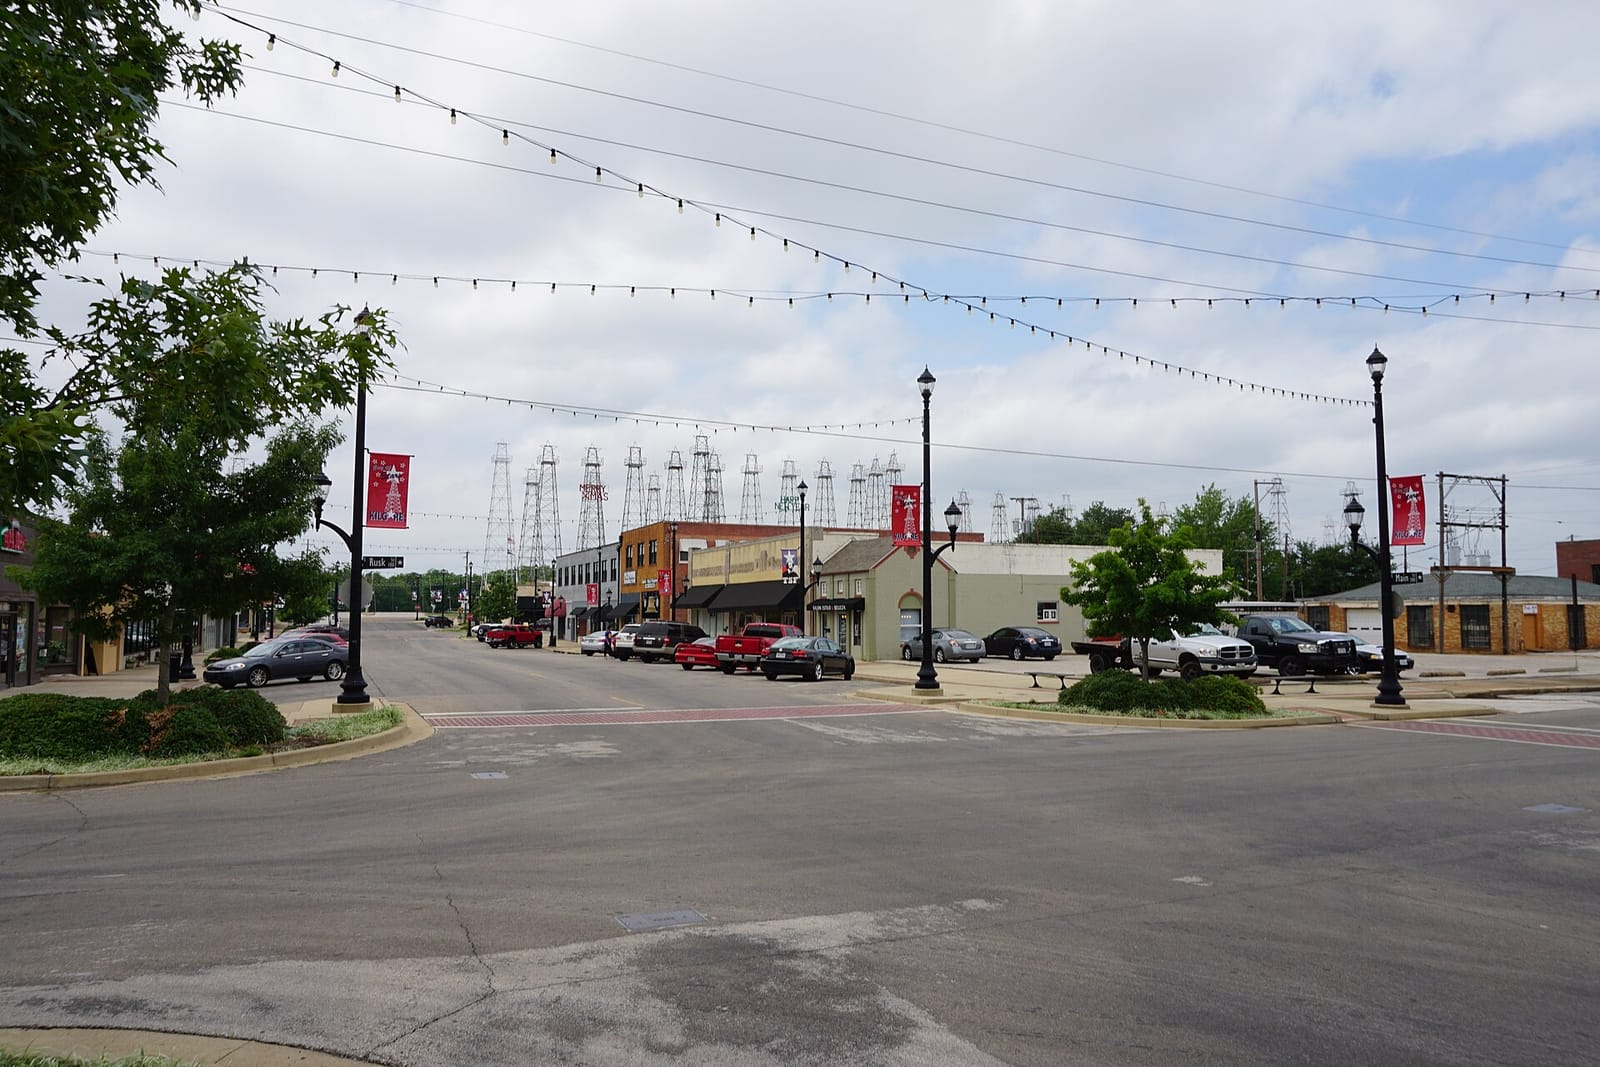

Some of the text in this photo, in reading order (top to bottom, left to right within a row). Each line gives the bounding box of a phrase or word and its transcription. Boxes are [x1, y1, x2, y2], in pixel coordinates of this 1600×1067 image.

[579, 484, 606, 492] MERRY
[582, 491, 608, 501] XMAS
[369, 557, 386, 567] Rusk
